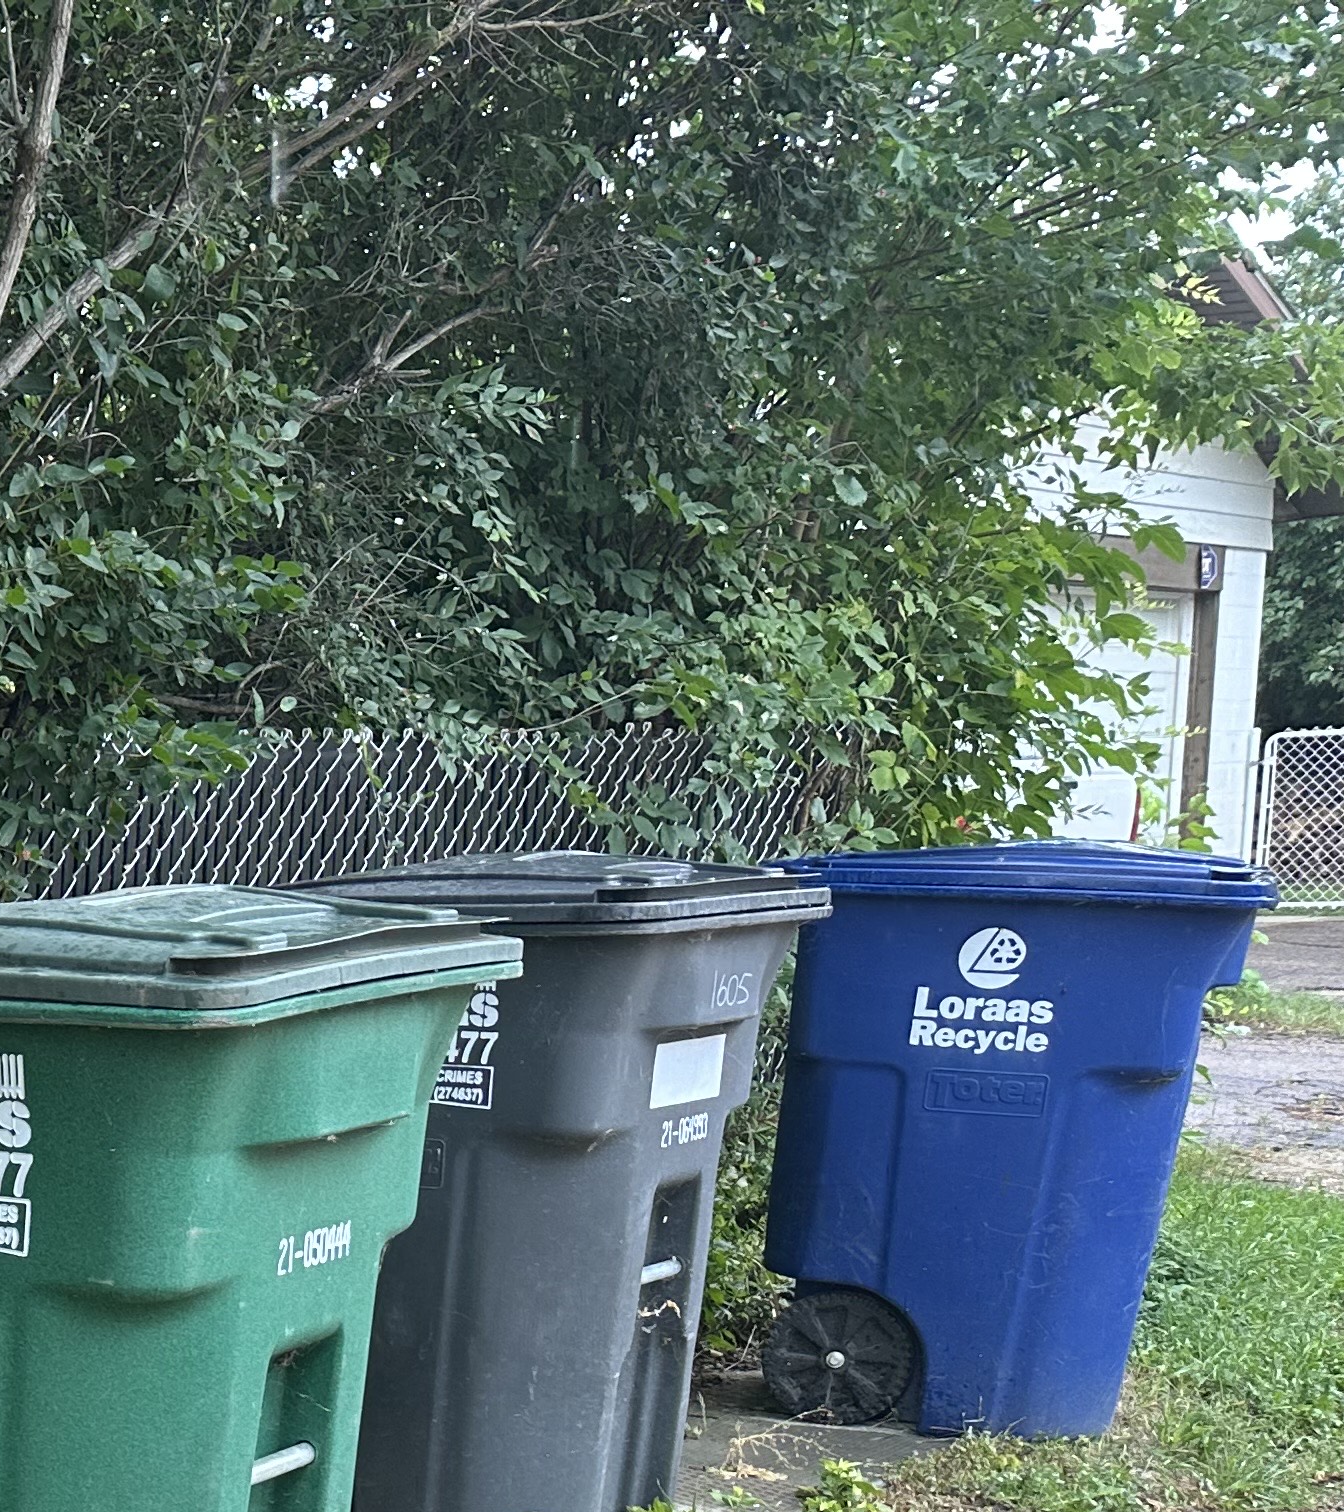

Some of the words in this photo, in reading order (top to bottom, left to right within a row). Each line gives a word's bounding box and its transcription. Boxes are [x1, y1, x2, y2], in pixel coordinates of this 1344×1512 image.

[711, 969, 752, 1009] 1605
[913, 986, 1054, 1024] Loraas
[909, 1018, 1049, 1054] Recycle
[433, 1086, 483, 1104] (274637)
[436, 1069, 483, 1085] CRIMES
[931, 1073, 1045, 1107] Toter
[277, 1219, 351, 1275] 21-050444
